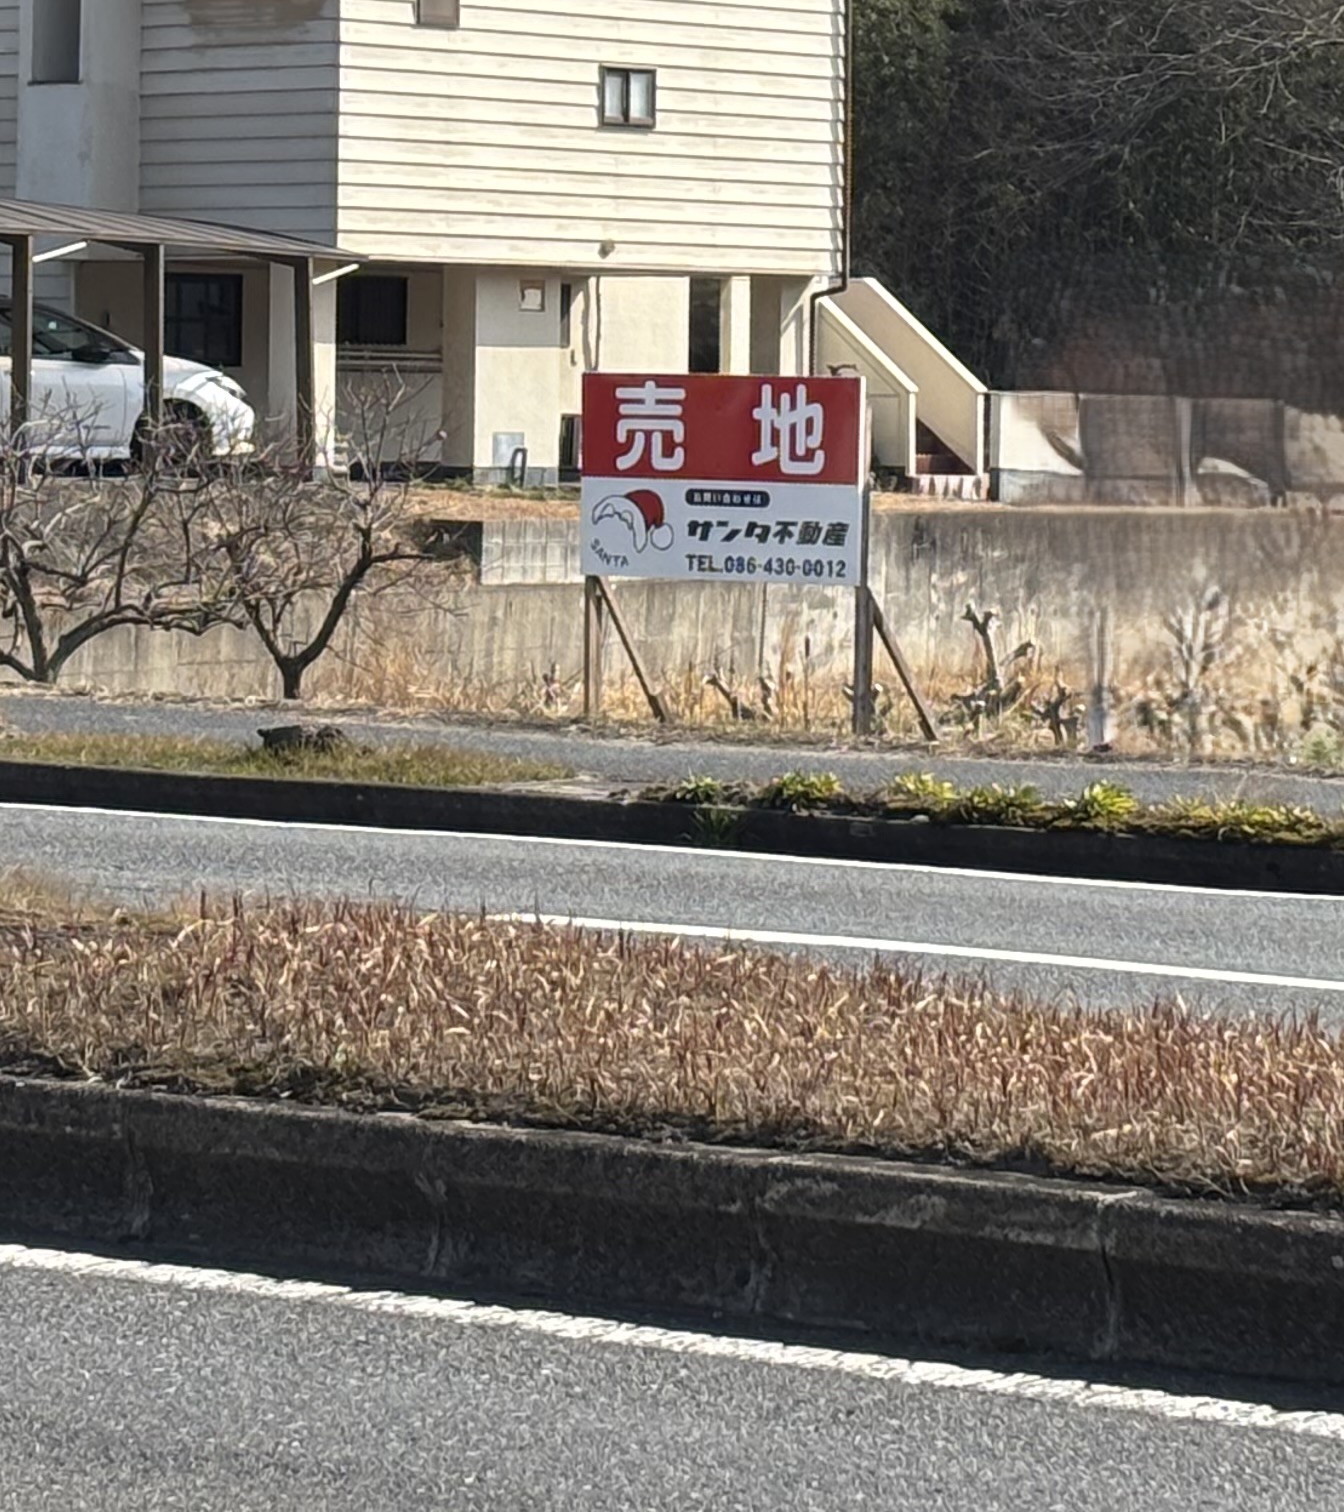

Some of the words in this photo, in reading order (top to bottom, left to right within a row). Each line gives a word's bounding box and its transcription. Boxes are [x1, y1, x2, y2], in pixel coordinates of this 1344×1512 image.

[615, 380, 825, 474] 売地
[687, 519, 850, 546] サンタ不動産
[590, 538, 629, 568] SANTA
[685, 553, 847, 578] TEL.086-430-0012
